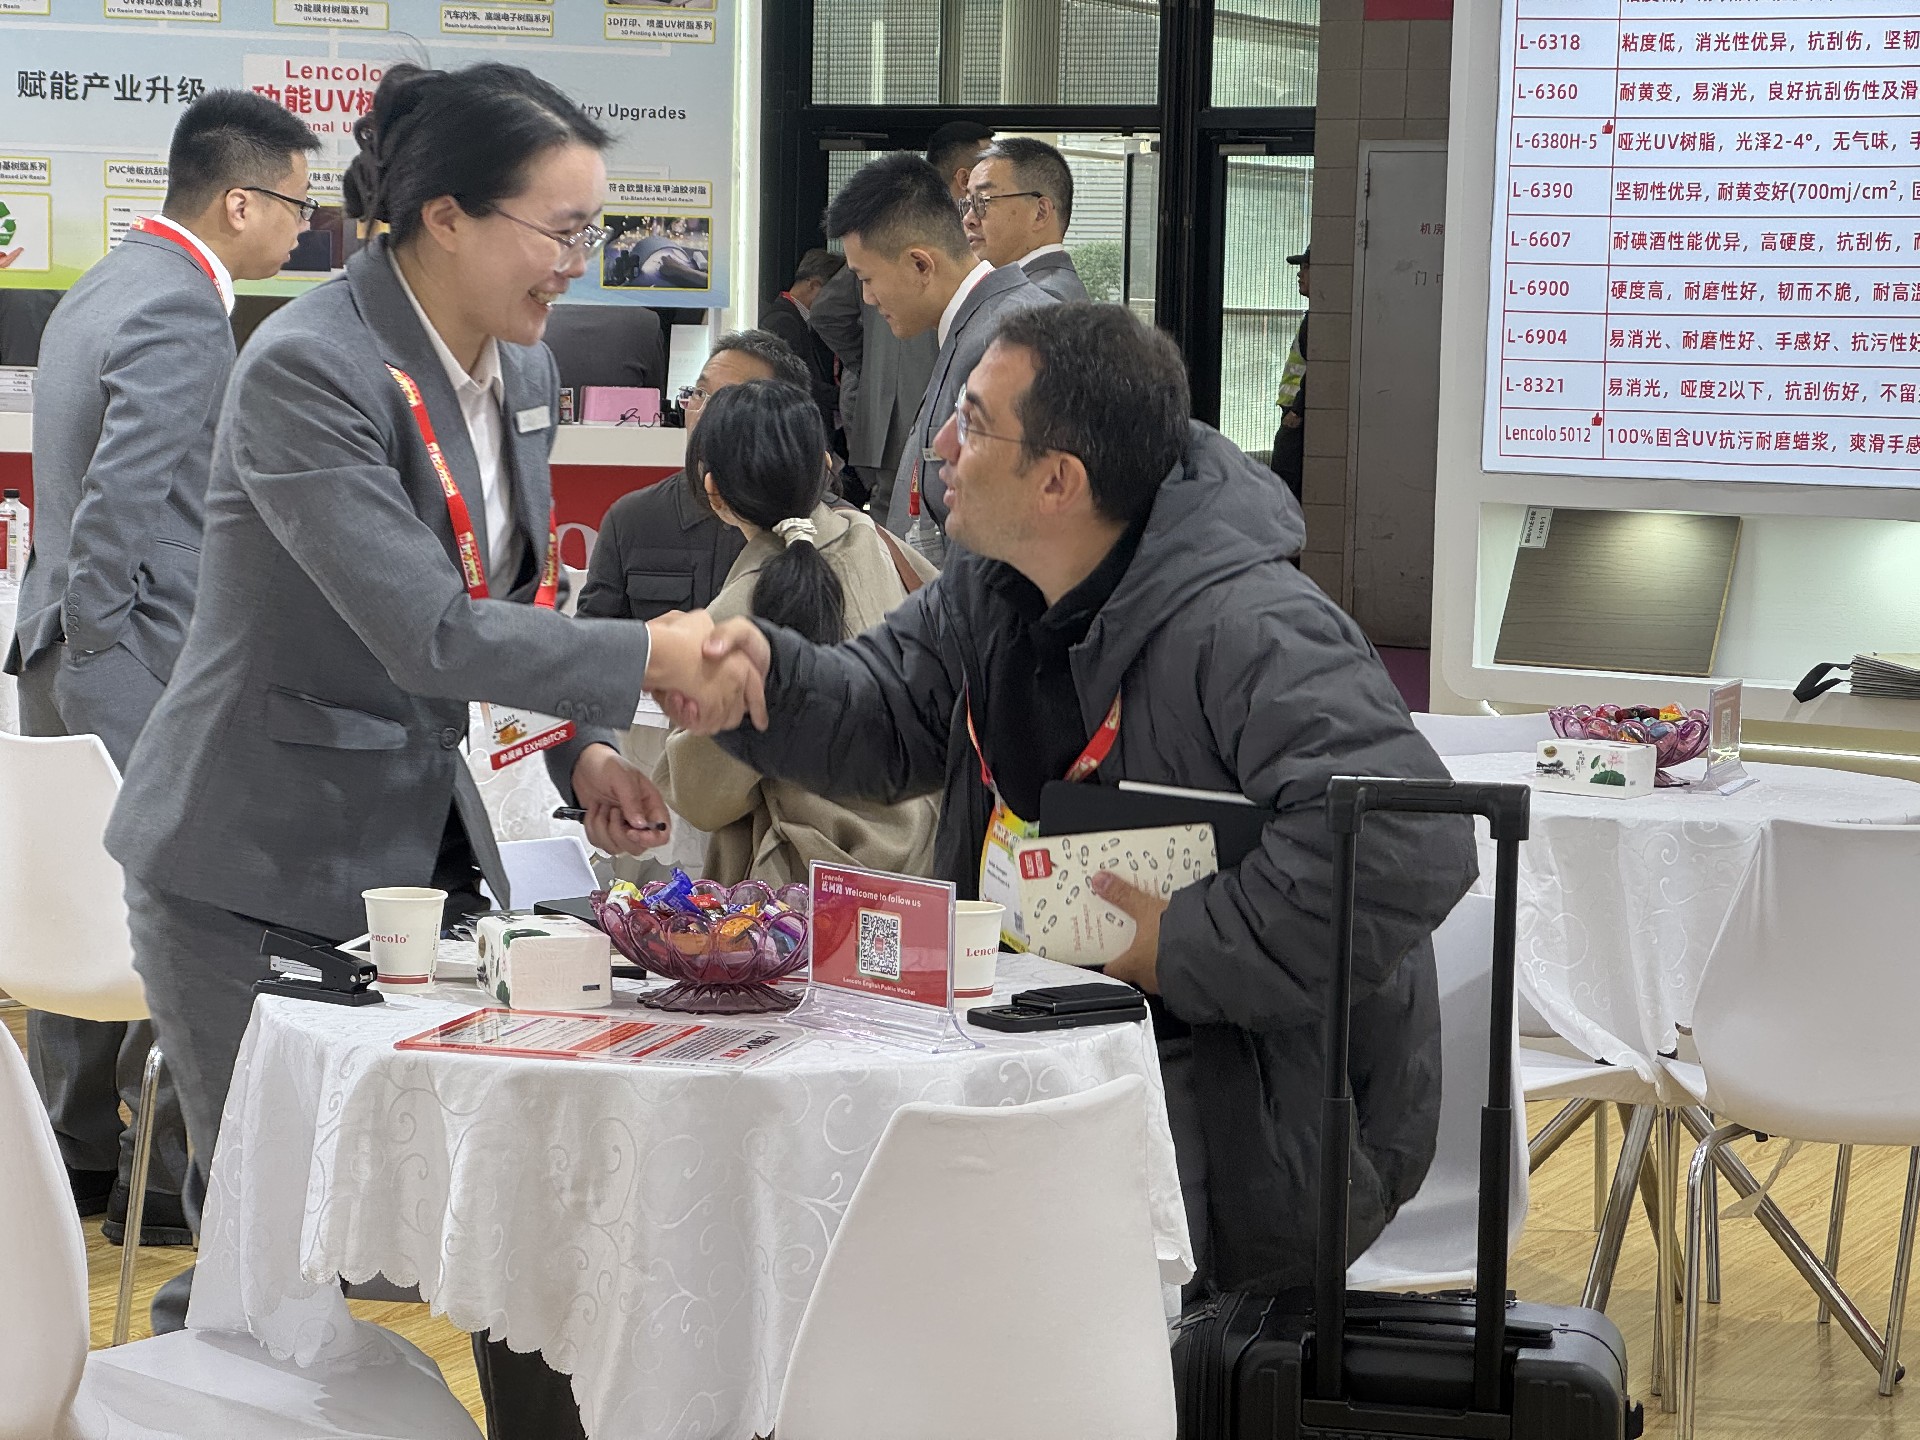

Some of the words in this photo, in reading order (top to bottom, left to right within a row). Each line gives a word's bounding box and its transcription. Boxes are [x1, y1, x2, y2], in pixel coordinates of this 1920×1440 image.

[607, 18, 713, 30] 3D打印、喷墨UV树脂系列
[1519, 34, 1581, 51] L-6318
[285, 60, 382, 82] Lencolo
[17, 70, 205, 103] 赋能产业升级
[1517, 84, 1578, 100] L-6360
[608, 103, 686, 121] Upgrades
[1515, 133, 1598, 149] L-6380H-5
[0, 160, 47, 172] 基树脂系列
[1512, 182, 1573, 198] L-6390
[1510, 232, 1571, 248] L-6607
[1509, 280, 1570, 296] L-6900
[1507, 328, 1568, 345] L-6904
[1506, 377, 1565, 393] L-8321
[1607, 378, 1920, 404] 易消光，哑度2以下，抗刮伤好，不留
[1505, 425, 1557, 442] Lencolo
[1559, 426, 1592, 442] 5012
[524, 729, 567, 755] EXHIBITOR
[845, 886, 879, 900] Welcome
[879, 892, 887, 901] to
[888, 894, 911, 906] follow
[911, 899, 922, 908] us
